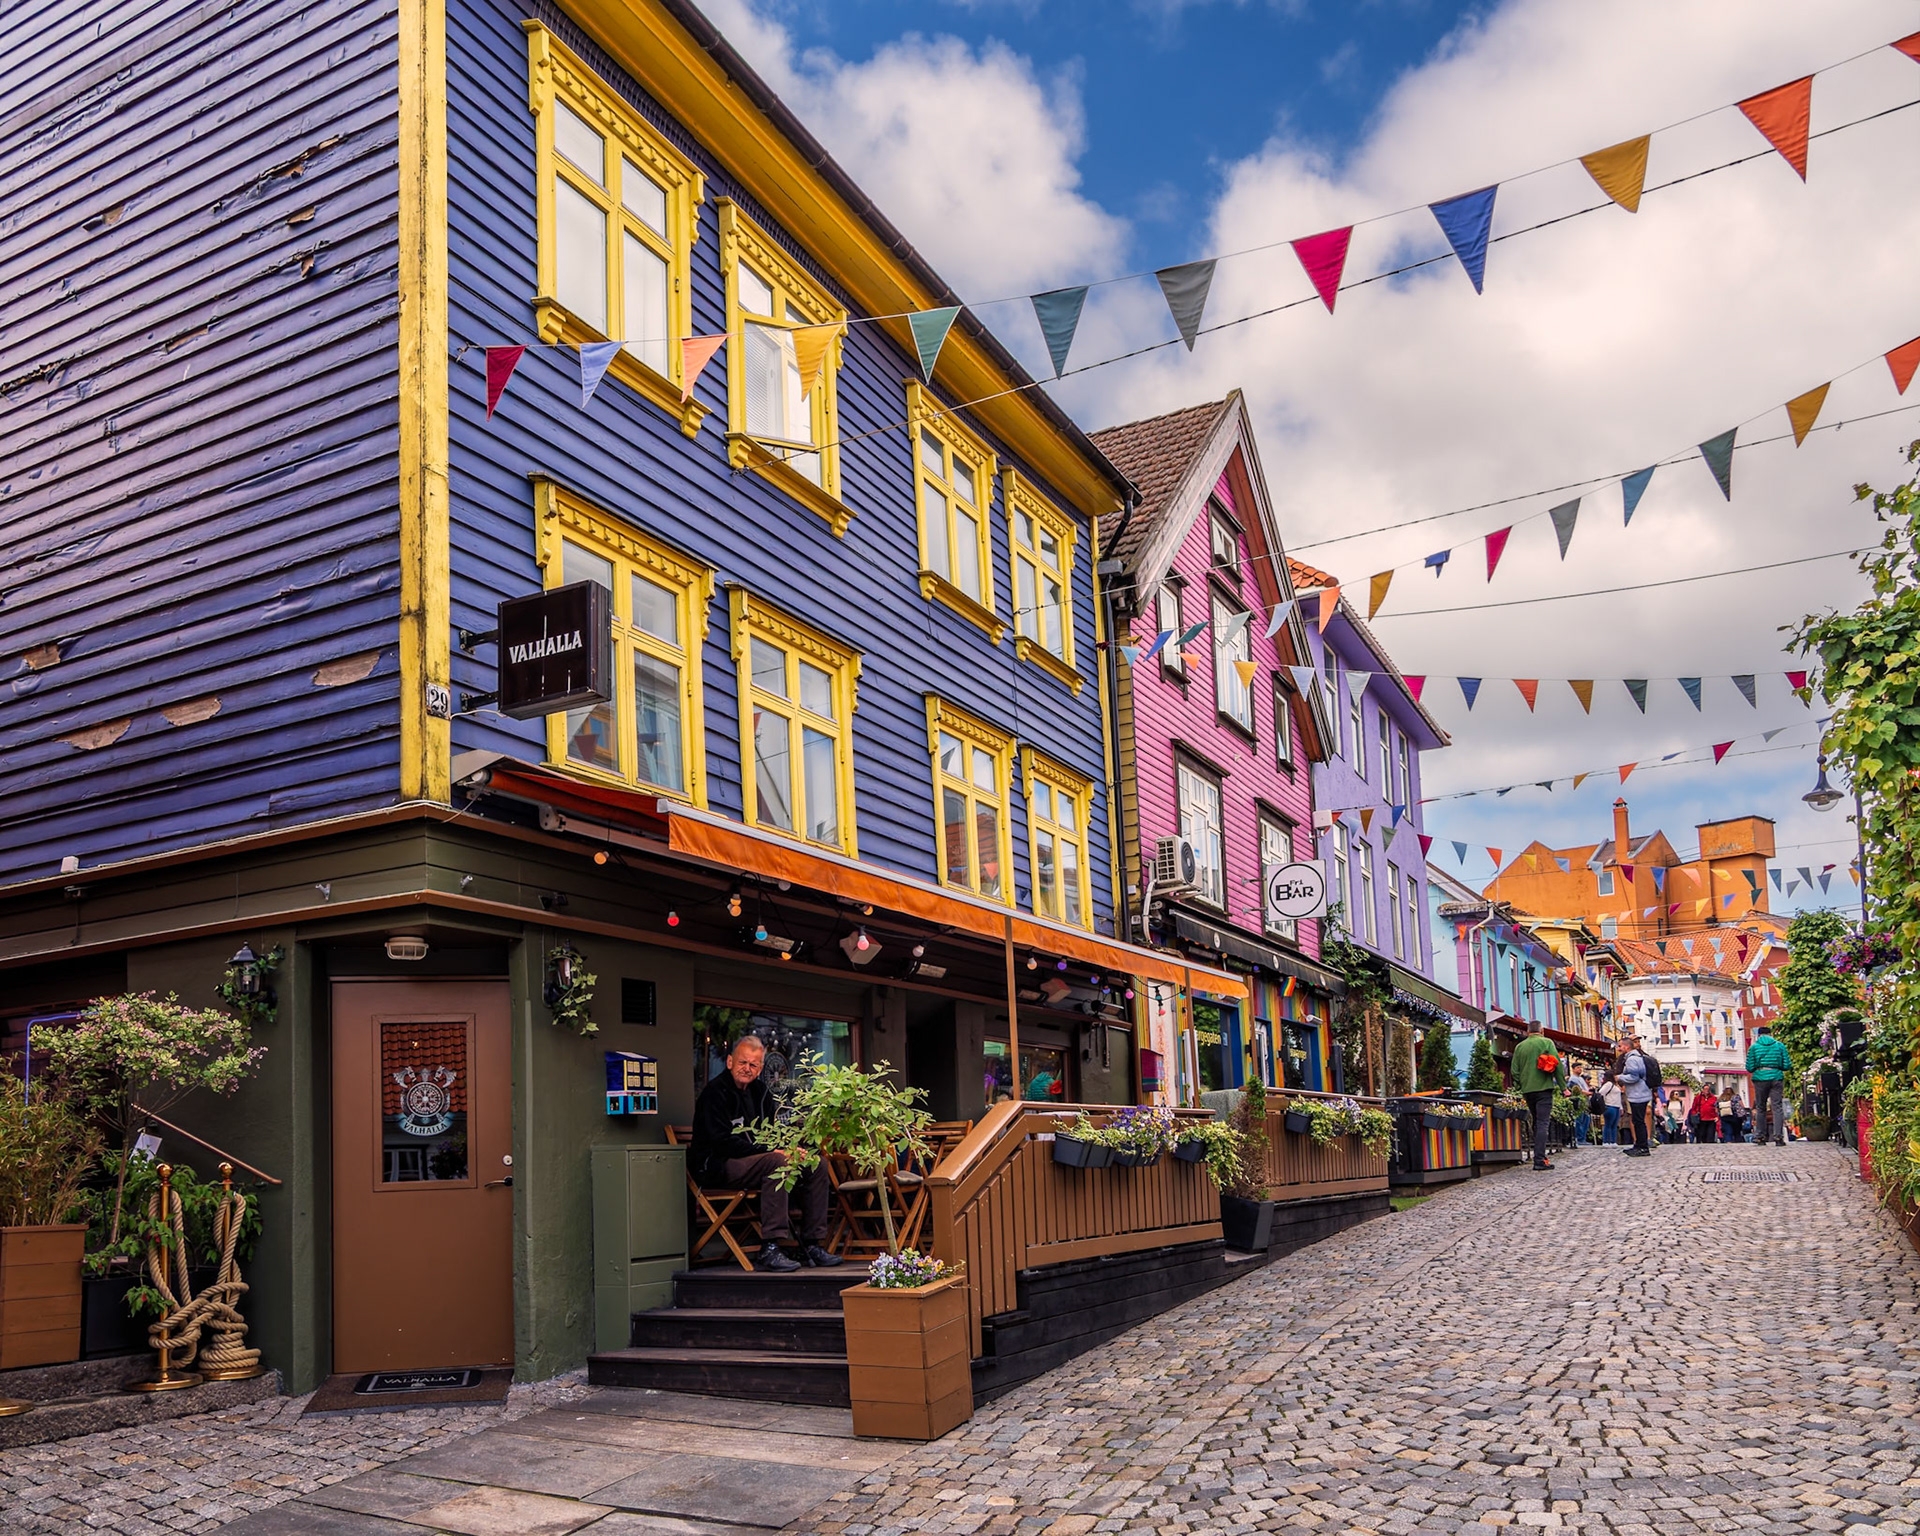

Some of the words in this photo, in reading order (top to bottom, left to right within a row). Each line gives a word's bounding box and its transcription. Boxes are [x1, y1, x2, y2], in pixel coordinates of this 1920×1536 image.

[509, 630, 582, 664] VALHALLA
[430, 688, 448, 714] 29
[1275, 884, 1314, 901] BAR
[403, 1122, 448, 1135] VALHALLA
[384, 1375, 457, 1384] VALHALLA
